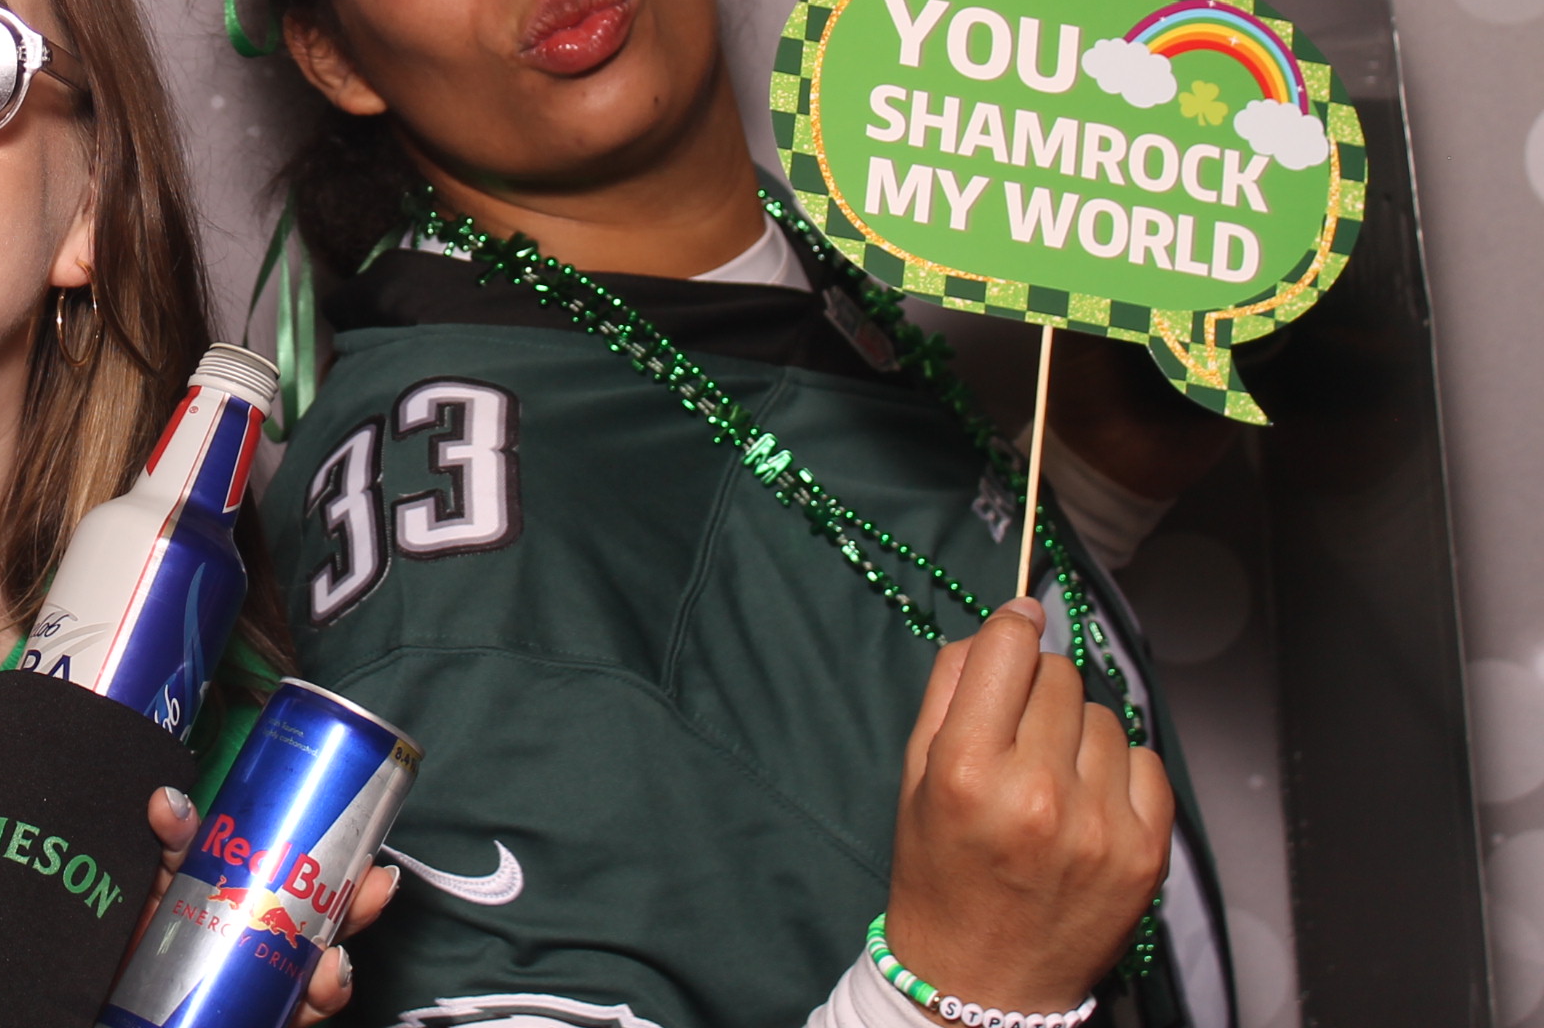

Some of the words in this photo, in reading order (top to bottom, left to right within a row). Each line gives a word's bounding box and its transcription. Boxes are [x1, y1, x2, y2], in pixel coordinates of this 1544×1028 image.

[864, 83, 1271, 213] SHAMROCK
[863, 155, 990, 231] MY
[1003, 181, 1262, 284] WORLD
[304, 375, 524, 629] 33
[201, 812, 293, 884] Red
[282, 853, 356, 925] Bull
